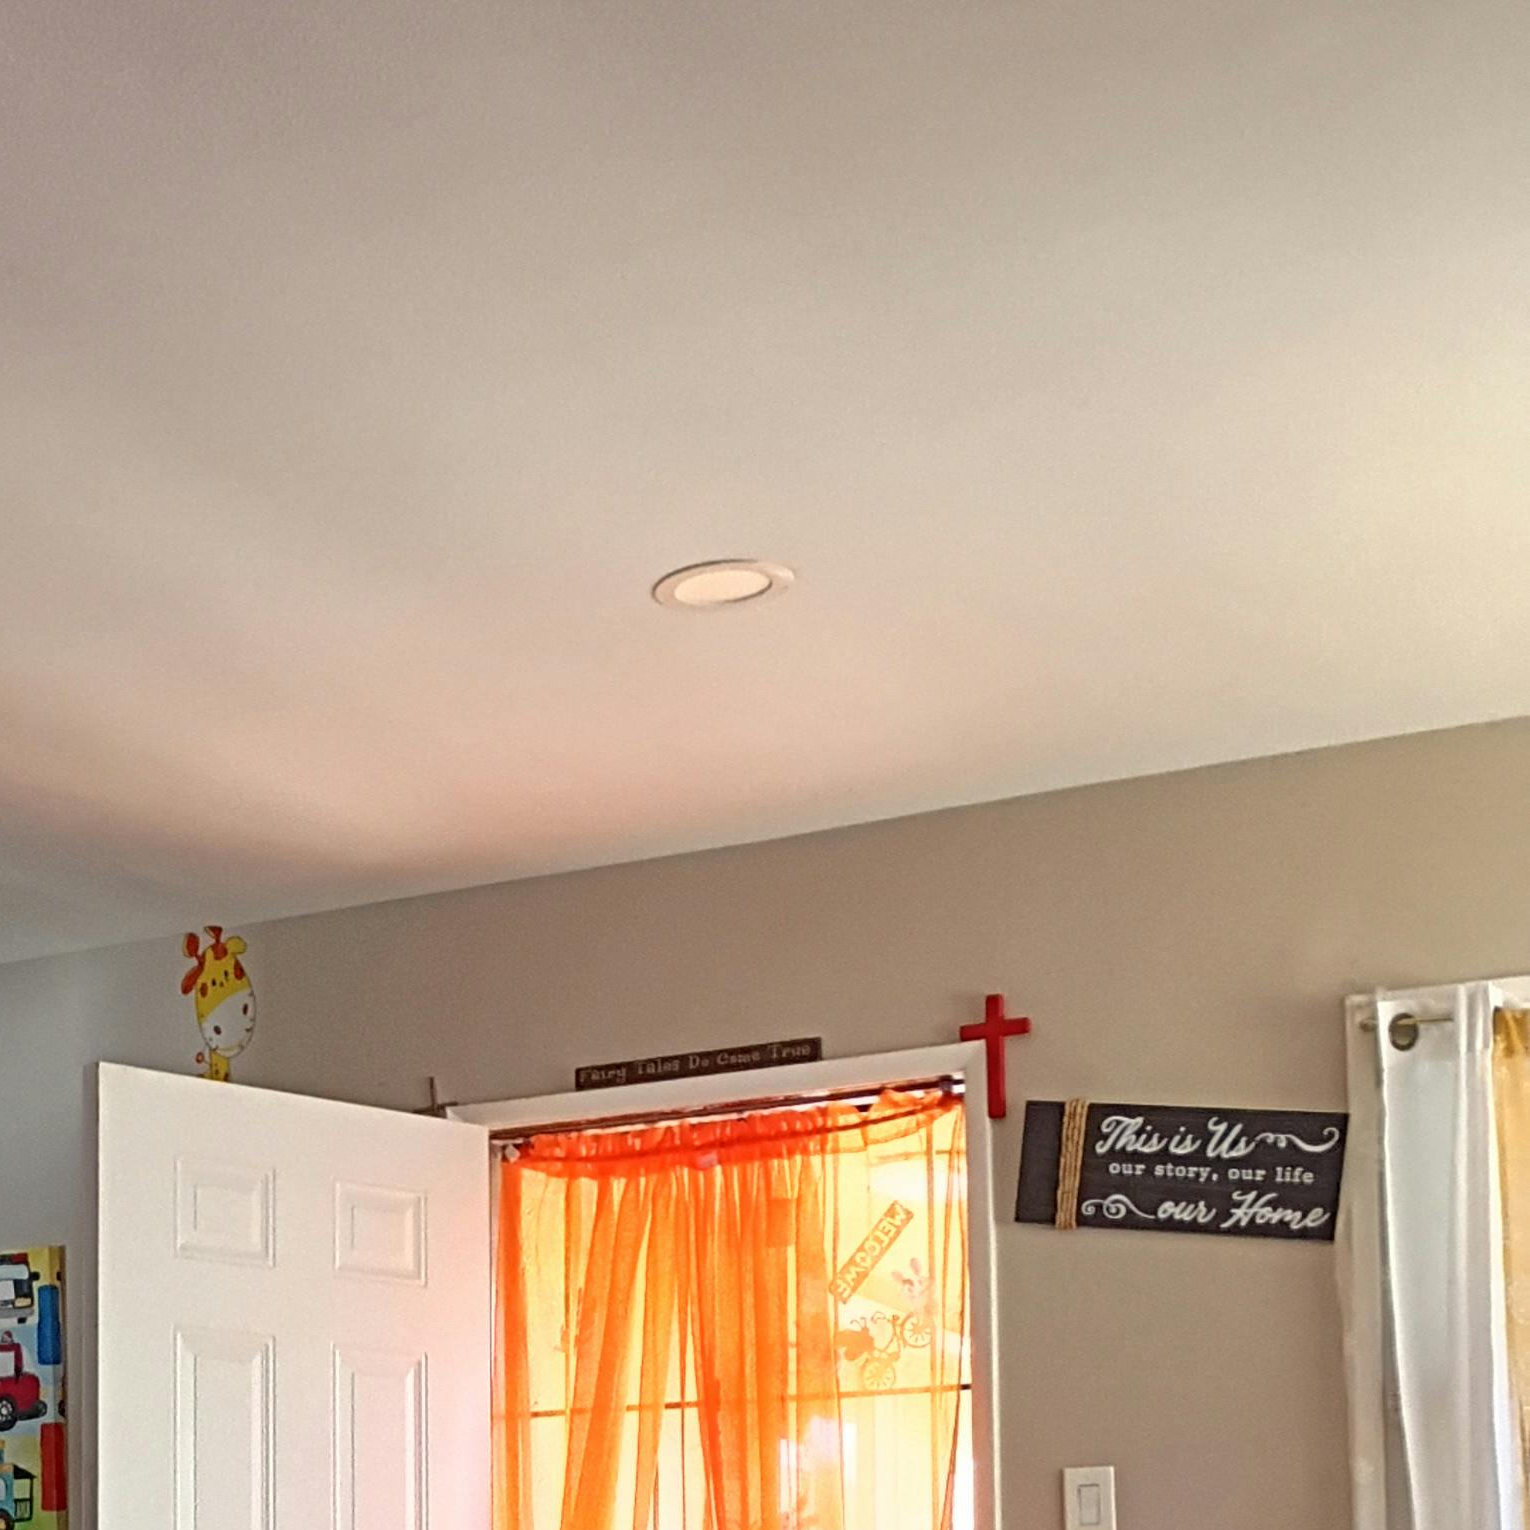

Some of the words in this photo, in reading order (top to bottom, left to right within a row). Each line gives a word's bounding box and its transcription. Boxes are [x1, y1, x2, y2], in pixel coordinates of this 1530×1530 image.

[579, 1067, 627, 1085] Fairy
[635, 1058, 681, 1076] Tales
[687, 1054, 711, 1071] Do
[716, 1050, 762, 1066] Come
[767, 1042, 812, 1061] True
[1095, 1114, 1170, 1156] This
[1170, 1126, 1202, 1156] is
[1207, 1115, 1257, 1160] Us
[1108, 1161, 1147, 1177] our
[1154, 1160, 1219, 1184] story,
[1228, 1165, 1267, 1183] our
[1275, 1166, 1315, 1185] life
[1156, 1200, 1217, 1225] our
[1219, 1189, 1332, 1230] Home
